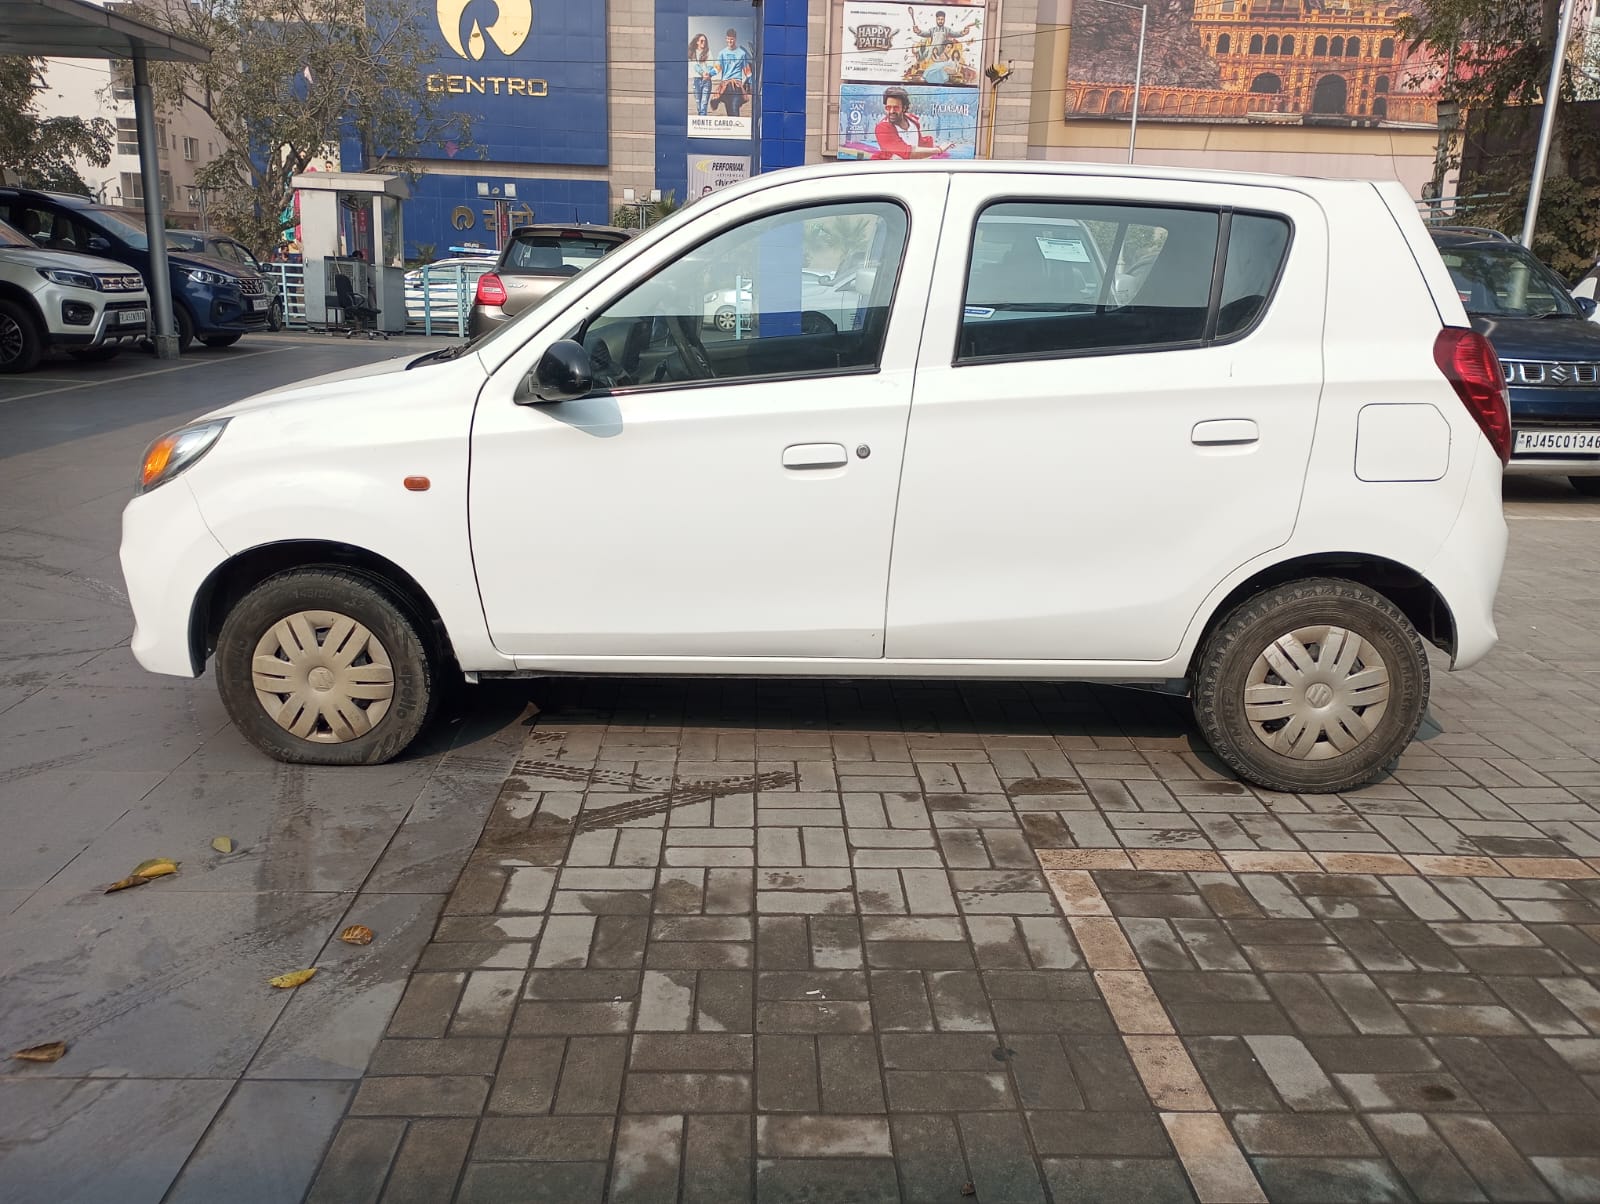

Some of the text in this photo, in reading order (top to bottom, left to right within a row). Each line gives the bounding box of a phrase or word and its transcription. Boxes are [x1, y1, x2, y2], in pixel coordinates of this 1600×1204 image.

[858, 26, 890, 38] HAPPY
[859, 37, 889, 48] PATEL
[426, 74, 548, 97] CENTRO
[850, 110, 862, 125] 9
[712, 162, 745, 172] PERFORMAX
